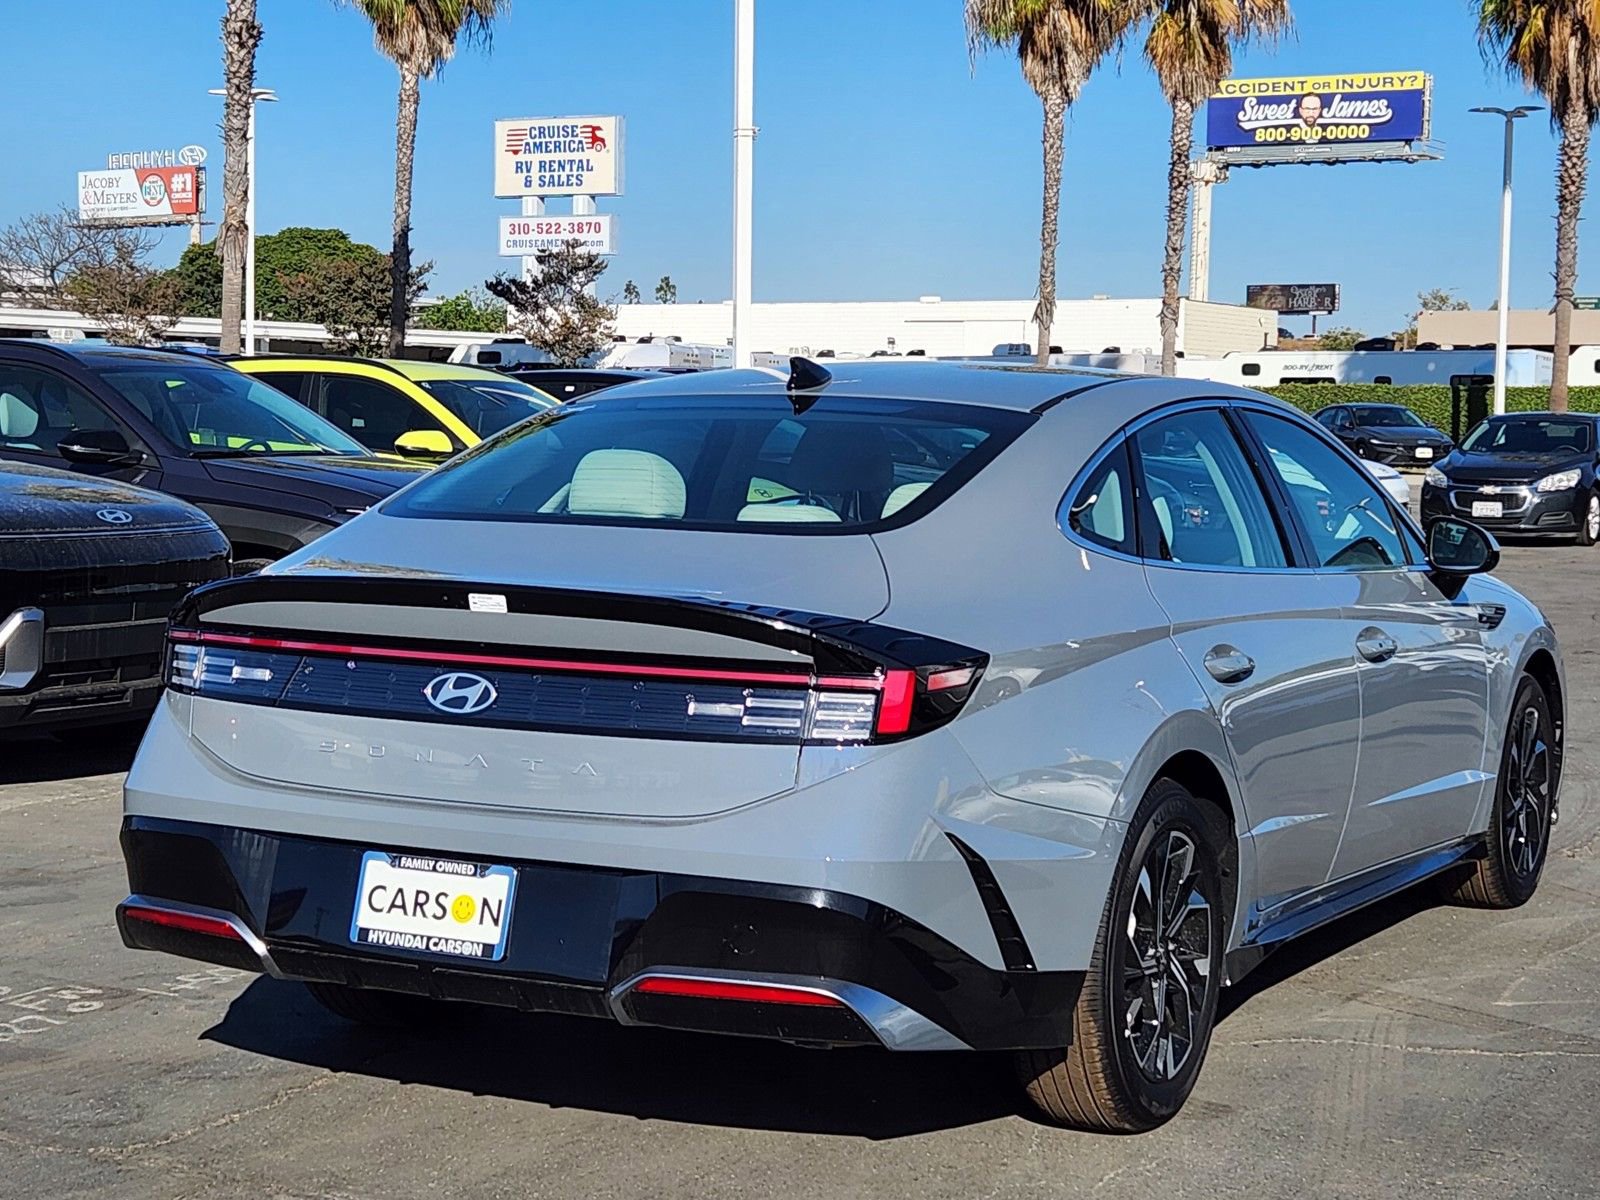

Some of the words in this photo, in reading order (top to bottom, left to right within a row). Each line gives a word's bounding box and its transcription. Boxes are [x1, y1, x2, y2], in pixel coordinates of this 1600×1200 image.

[1335, 75, 1418, 90] INJURY?
[1237, 96, 1297, 122] Sweet
[1321, 94, 1389, 119] James
[529, 124, 579, 139] CRUISE
[523, 139, 586, 155] AMERICA
[514, 160, 533, 174] RV
[538, 159, 594, 173] RENTAL
[81, 175, 121, 189] JACOBY
[171, 173, 193, 192] #1
[523, 175, 533, 188] &
[538, 174, 584, 188] SALES
[508, 221, 602, 235] 310-522-3870
[1288, 297, 1333, 309] HARBR
[400, 856, 435, 871] FAMILY
[435, 860, 475, 875] OWNED
[367, 884, 503, 927] CARSON
[367, 929, 427, 949] HYUNDAI
[428, 936, 484, 957] CARSON
